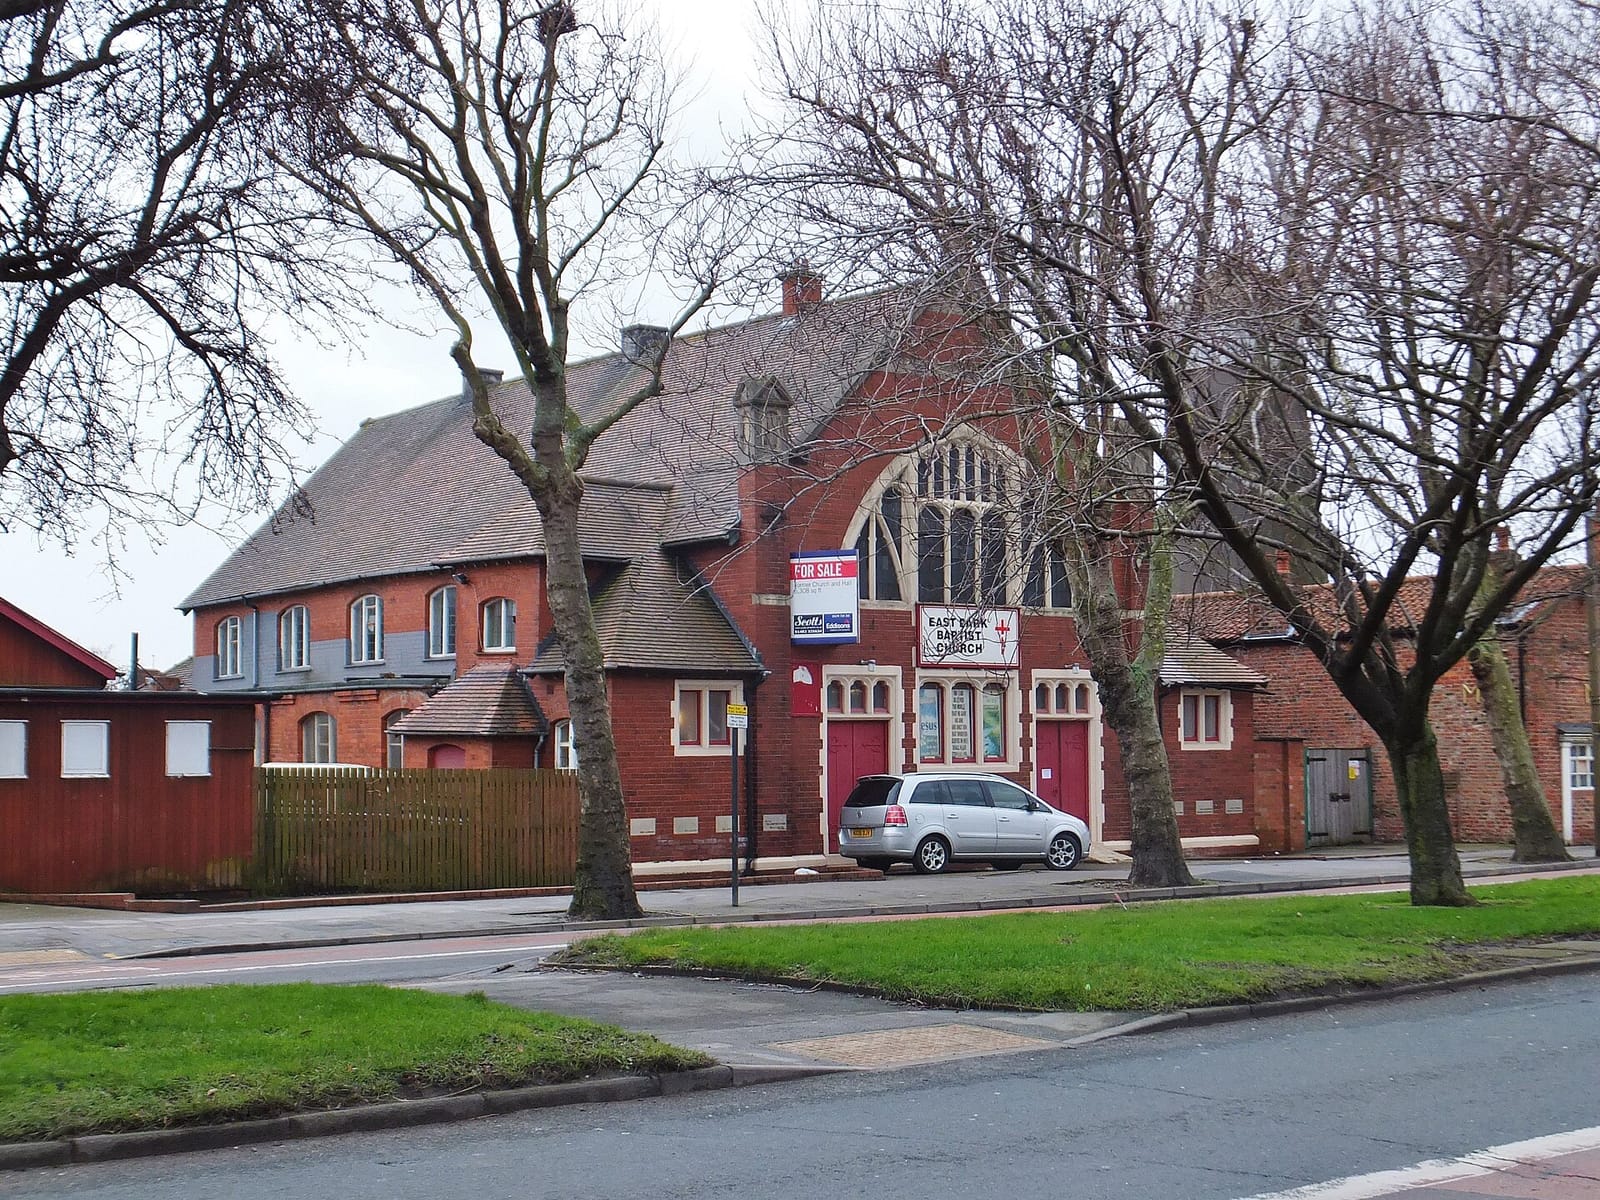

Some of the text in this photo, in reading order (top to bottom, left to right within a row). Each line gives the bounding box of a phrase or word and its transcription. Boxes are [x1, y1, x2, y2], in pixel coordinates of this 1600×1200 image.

[795, 563, 842, 578] FOR SALE
[928, 617, 956, 627] EAST
[937, 630, 982, 641] BAPTIST
[937, 643, 983, 654] CHURCH
[920, 722, 938, 731] esus
